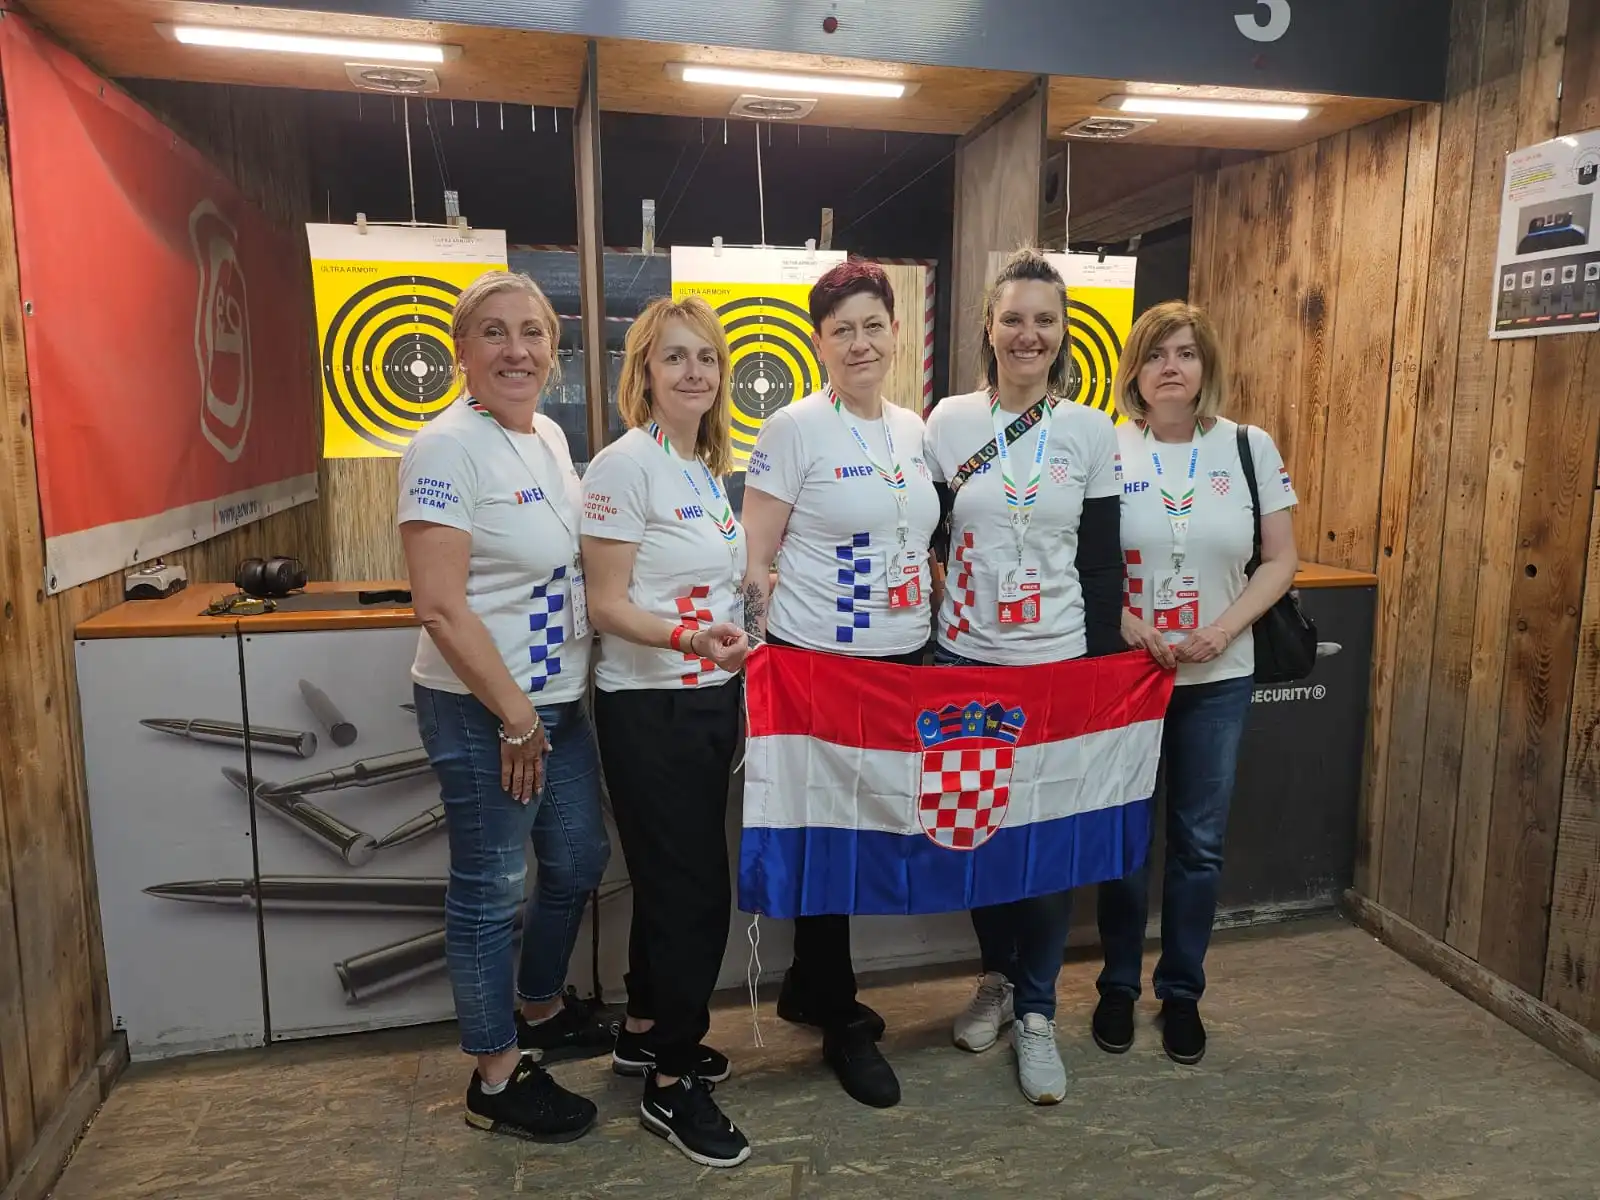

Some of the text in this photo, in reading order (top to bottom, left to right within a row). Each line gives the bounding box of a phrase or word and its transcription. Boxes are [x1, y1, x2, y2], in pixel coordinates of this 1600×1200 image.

[320, 265, 378, 274] ULTRA ARMORY
[679, 287, 731, 296] ULTRA ARMORY
[1007, 408, 1041, 439] LOVE
[849, 465, 873, 477] HEP
[417, 477, 452, 491] SPORT
[1124, 481, 1149, 494] HEP
[409, 487, 459, 504] SHOOTING
[417, 497, 446, 510] TEAM
